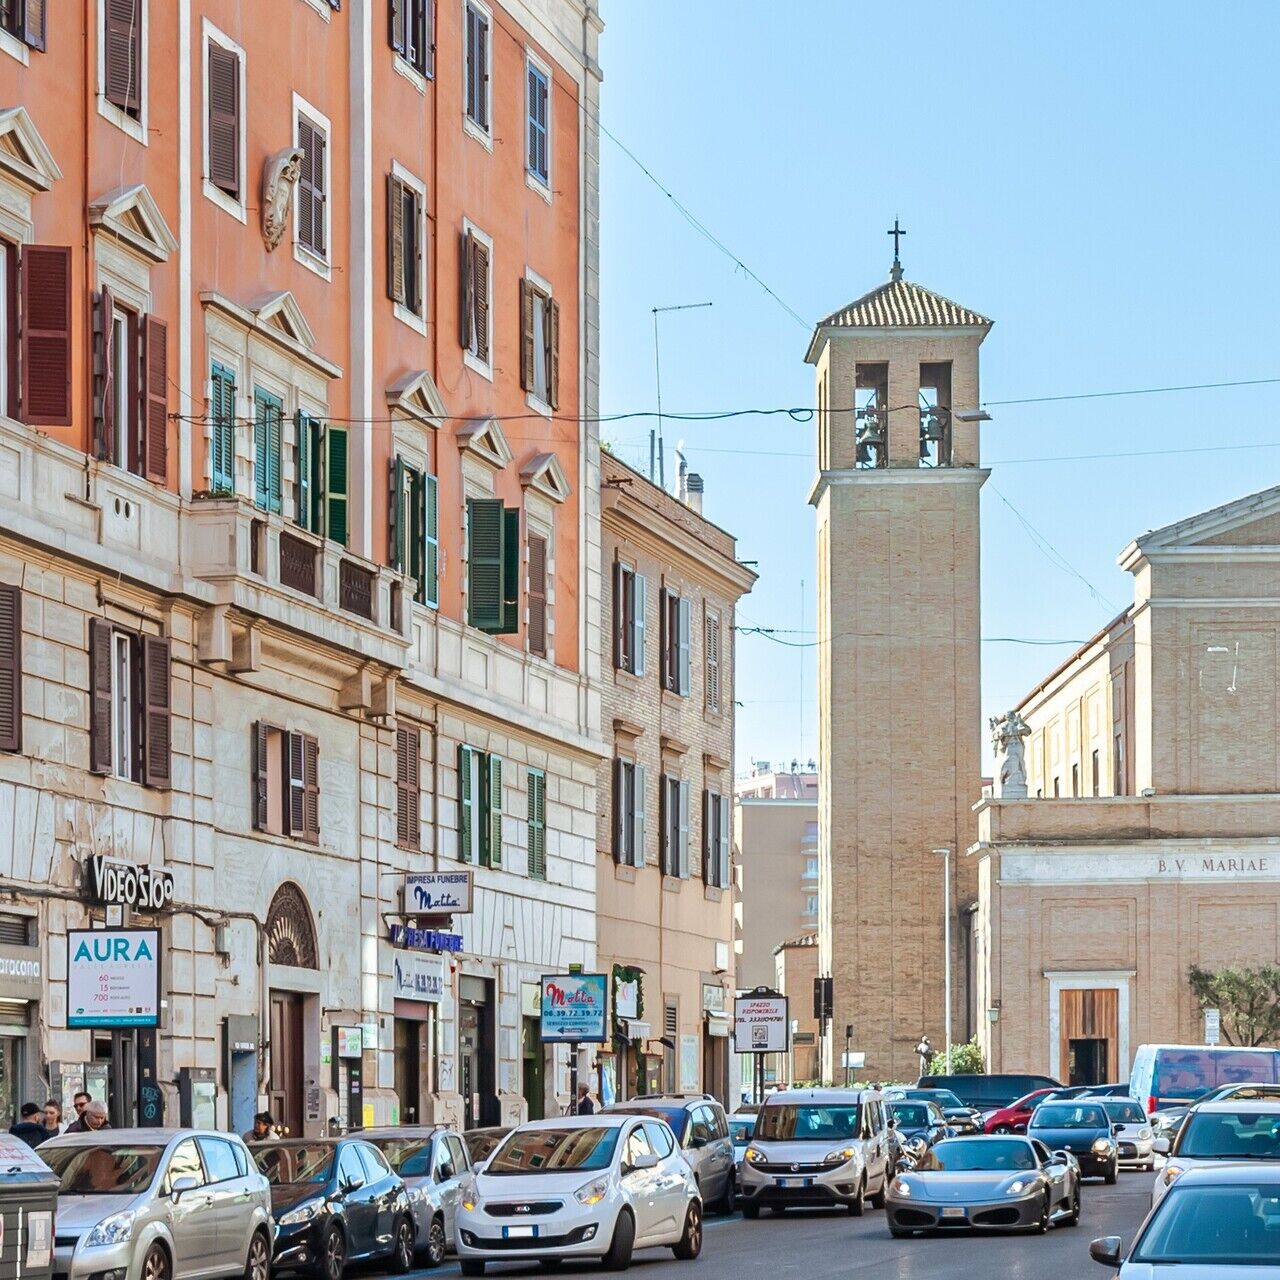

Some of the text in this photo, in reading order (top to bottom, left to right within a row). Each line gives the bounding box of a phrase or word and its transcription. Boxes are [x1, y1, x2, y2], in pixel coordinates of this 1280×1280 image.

[1202, 858, 1269, 872] MARIAE
[407, 875, 468, 884] IMPRESA FUNEBRE
[74, 938, 153, 961] AURA
[546, 983, 594, 1007] Motta
